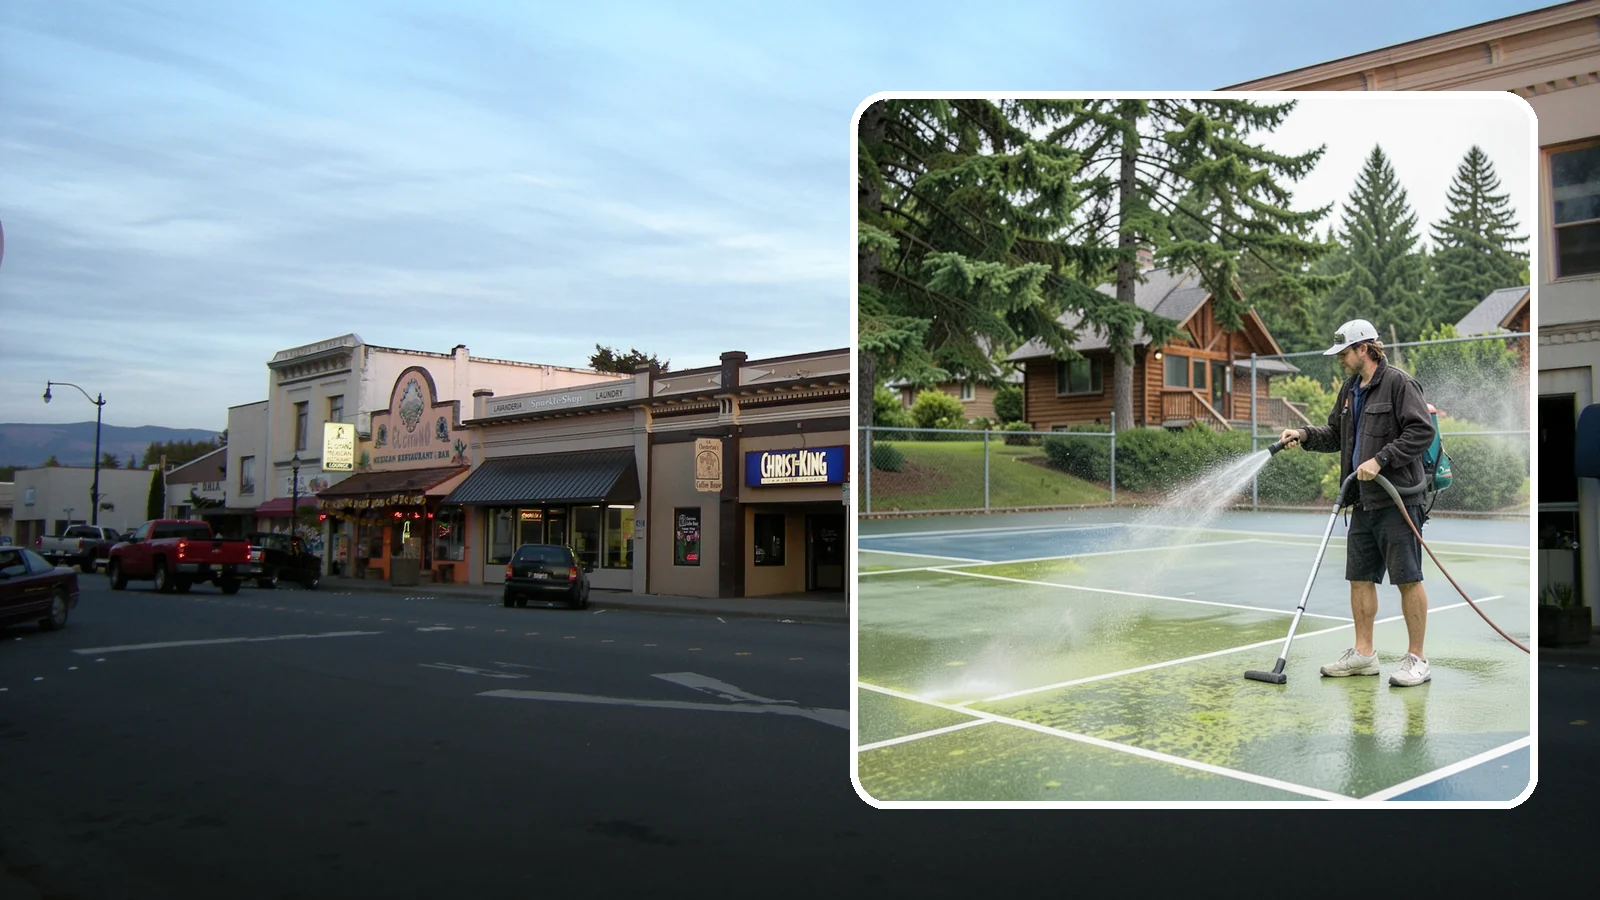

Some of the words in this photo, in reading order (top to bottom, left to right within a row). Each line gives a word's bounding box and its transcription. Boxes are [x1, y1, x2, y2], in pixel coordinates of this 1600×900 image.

[595, 389, 623, 400] LAUNDRY
[494, 402, 522, 412] LAVANDERIA
[373, 455, 396, 464] MEXICAN
[397, 451, 433, 462] RESTAURANT
[438, 450, 450, 459] BAR
[761, 452, 797, 477] CHRIST
[799, 450, 827, 476] KING
